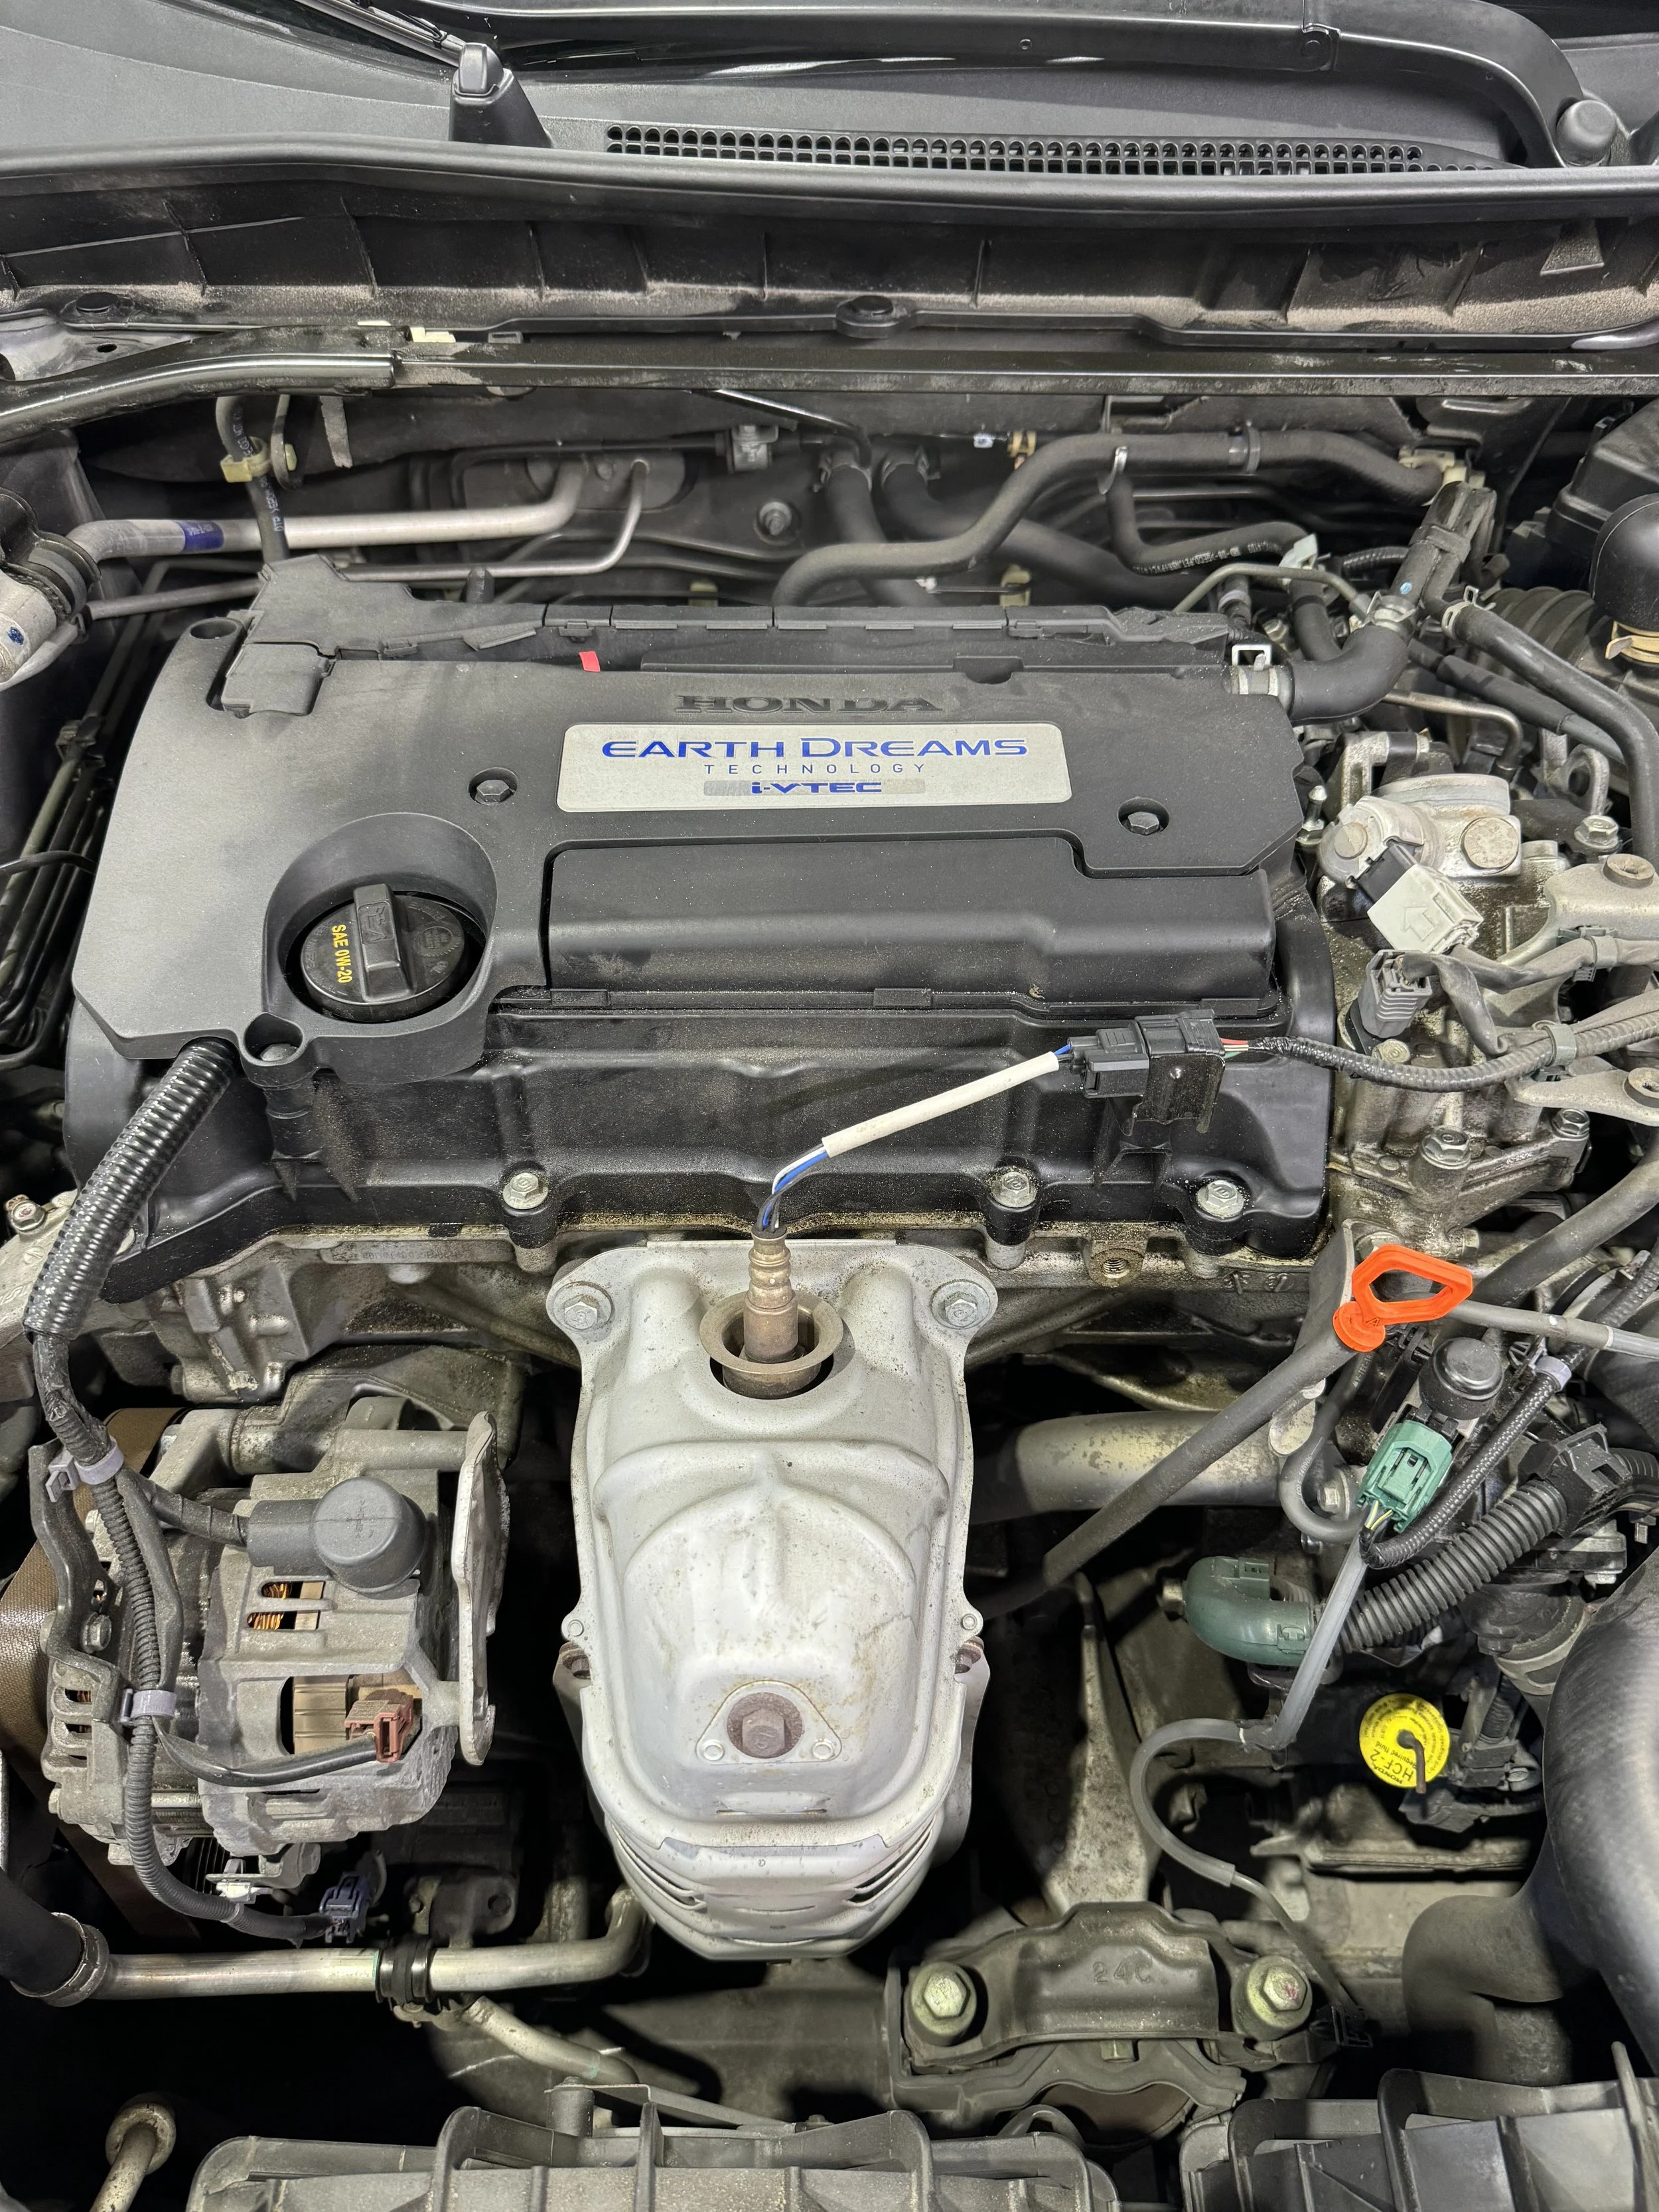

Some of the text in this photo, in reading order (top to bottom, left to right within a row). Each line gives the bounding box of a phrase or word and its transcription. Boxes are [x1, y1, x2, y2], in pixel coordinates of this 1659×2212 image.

[675, 694, 944, 714] HONDA
[601, 737, 1028, 759] EARTH DREAMS
[703, 764, 926, 775] TECHNOLOGY
[751, 781, 882, 794] i-VTEC
[331, 924, 353, 984] SAE 0W-20
[1375, 1740, 1390, 1754] fluid
[1372, 1761, 1404, 1784] HONDA
